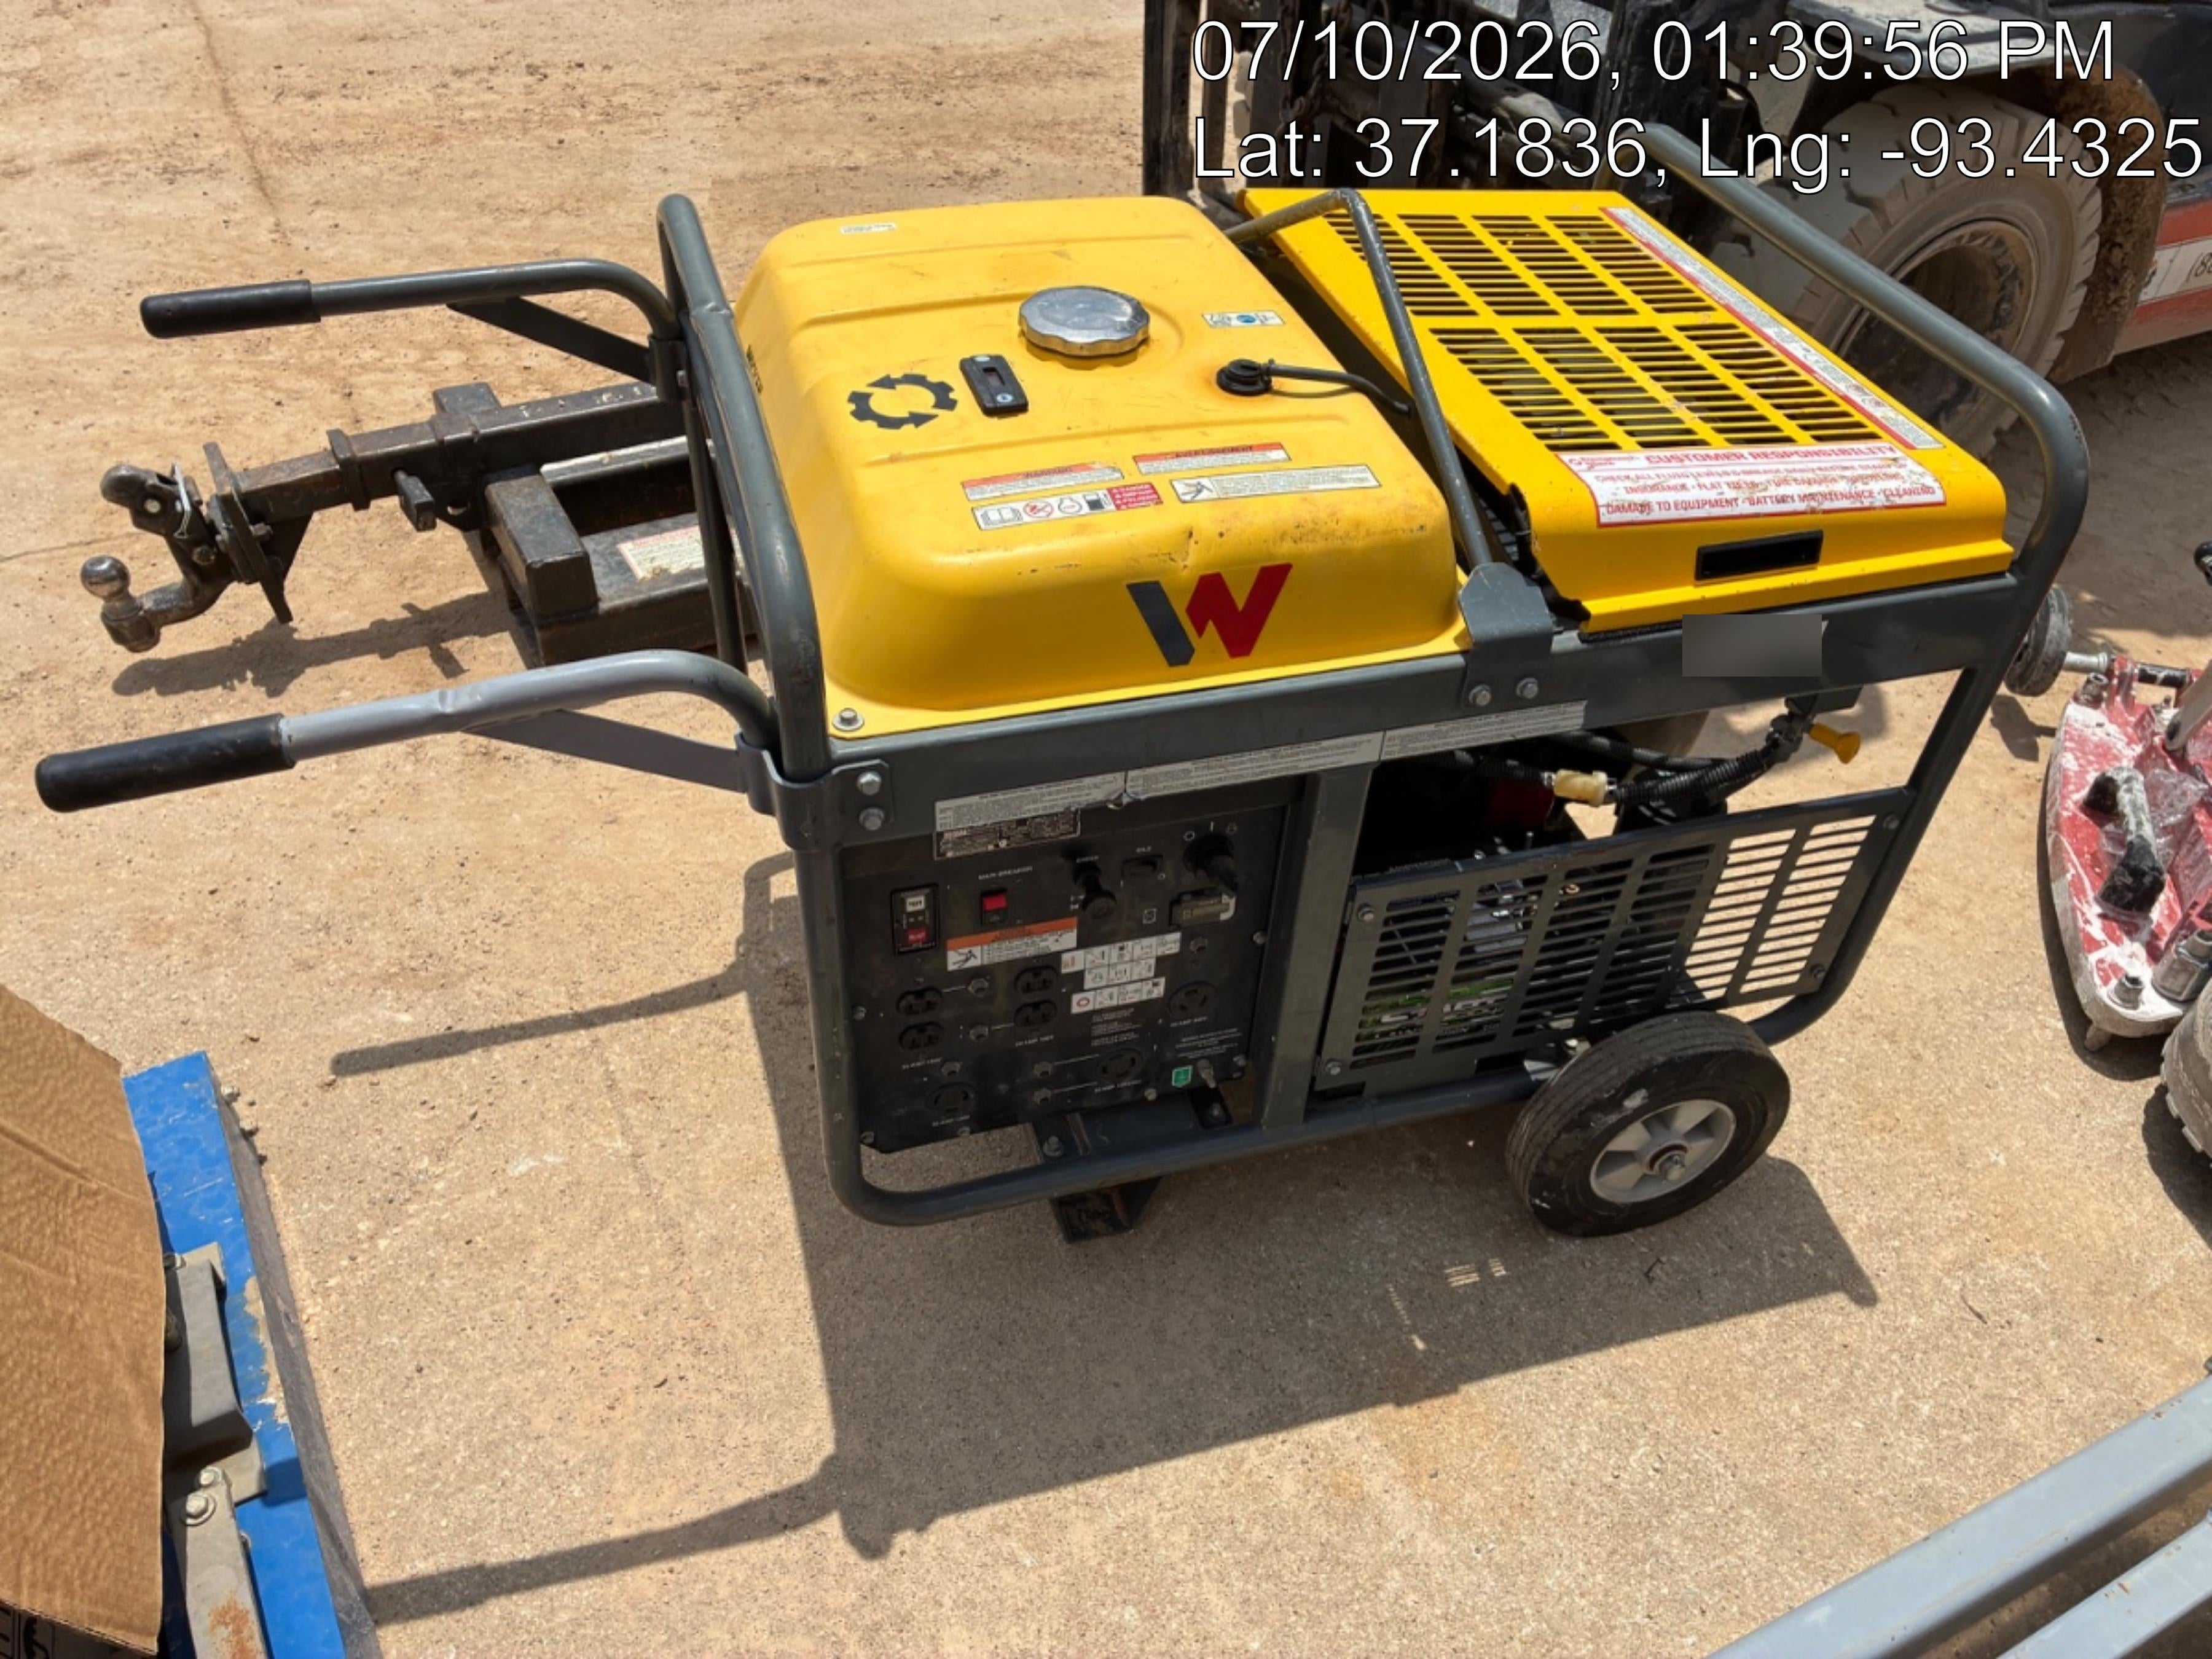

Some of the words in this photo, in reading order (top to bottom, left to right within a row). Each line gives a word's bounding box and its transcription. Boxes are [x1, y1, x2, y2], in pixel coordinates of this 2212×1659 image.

[1644, 450, 1747, 465] CUSTOMER
[1750, 445, 1895, 460] RESPONSIBILITY
[1657, 501, 1671, 511] TO
[1673, 497, 1739, 511] EQUIPMENT
[1749, 493, 1795, 506] BATTERY
